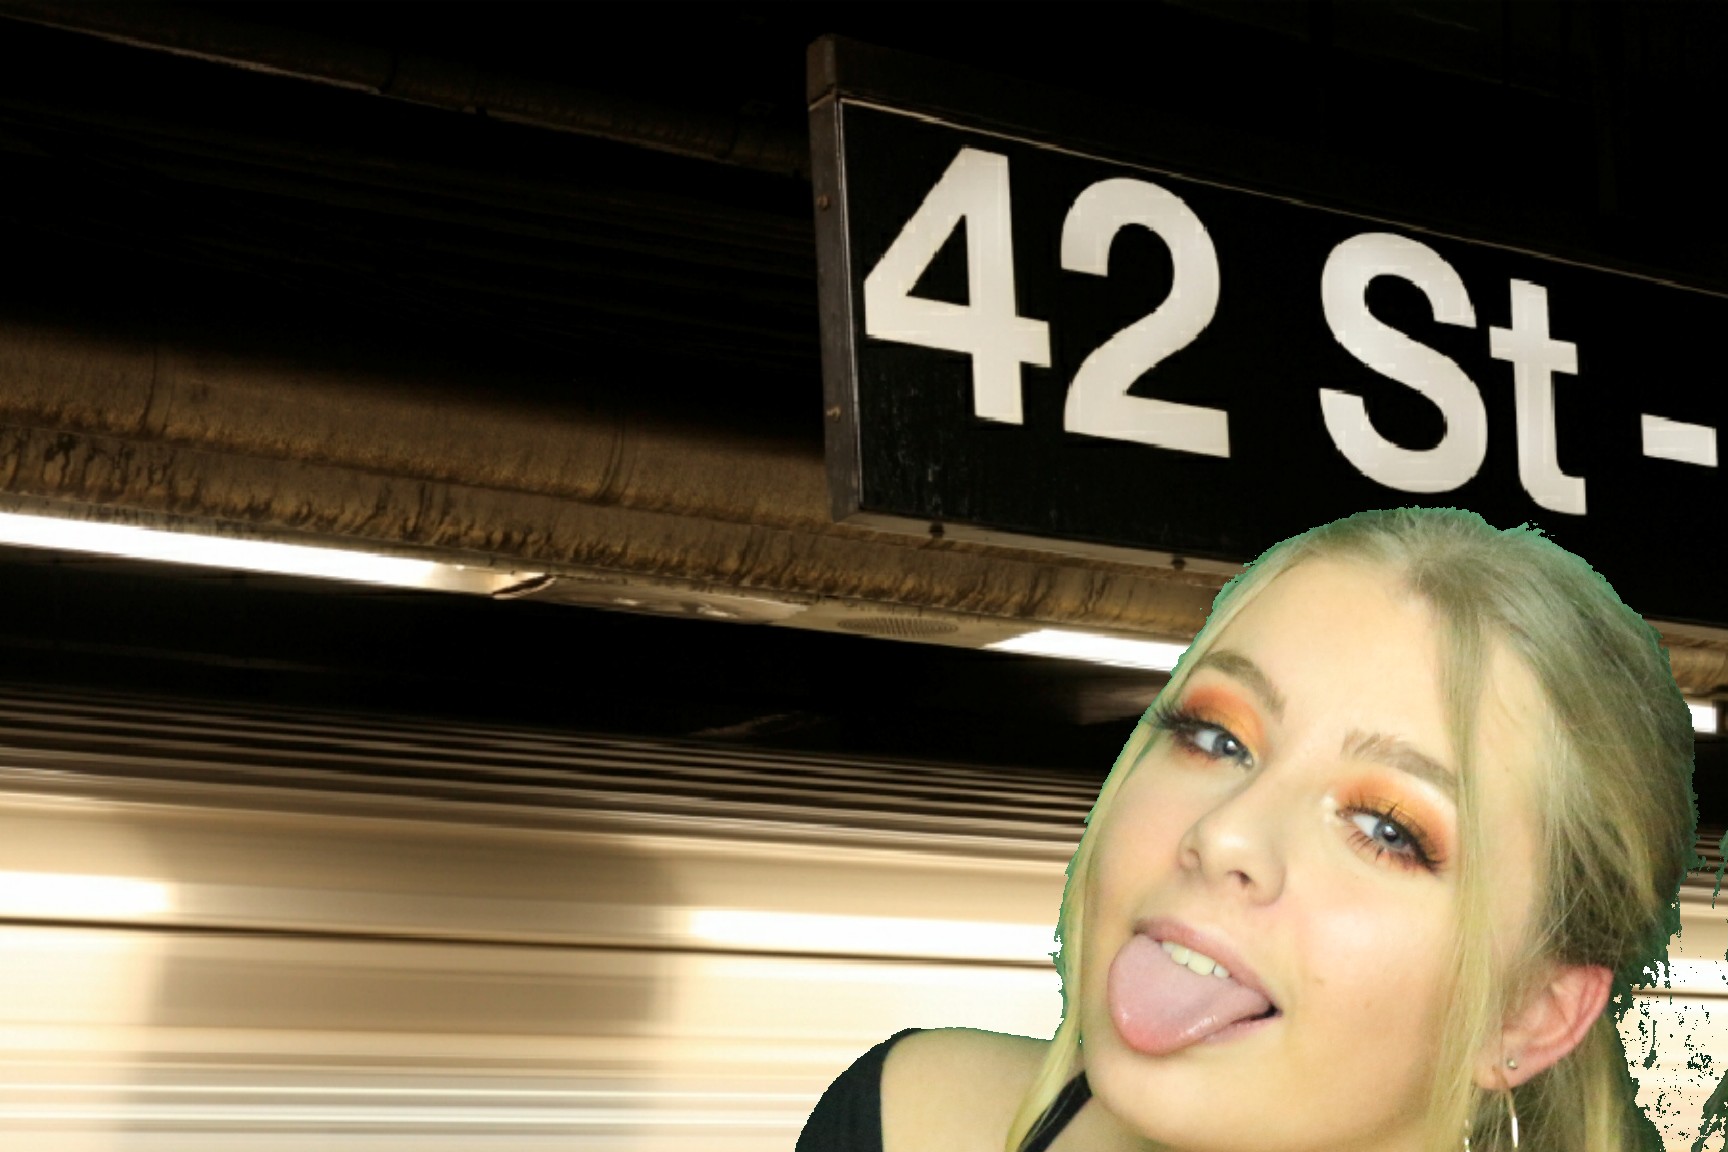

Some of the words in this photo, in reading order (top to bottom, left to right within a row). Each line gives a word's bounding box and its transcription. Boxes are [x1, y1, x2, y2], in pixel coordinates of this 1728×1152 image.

[863, 147, 1230, 458] 42
[1319, 232, 1587, 515] St
[1641, 413, 1718, 468] -
